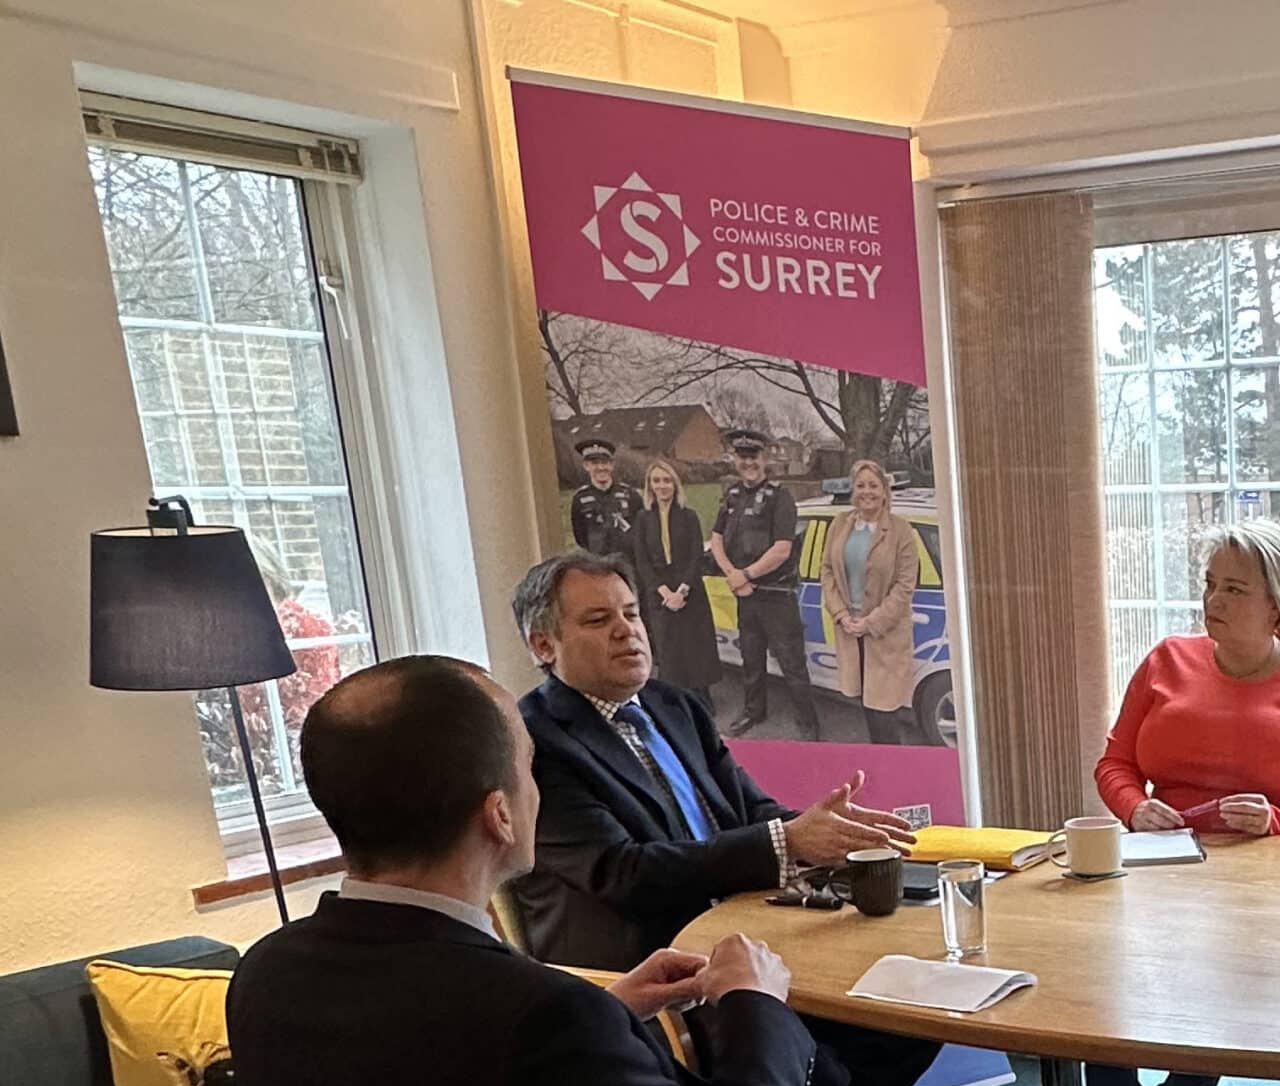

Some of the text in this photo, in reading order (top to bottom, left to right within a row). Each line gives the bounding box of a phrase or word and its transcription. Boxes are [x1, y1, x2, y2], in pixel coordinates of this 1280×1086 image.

[709, 198, 880, 234] POLICE & CRIME
[712, 226, 882, 256] COMMISSIONER FOR
[716, 251, 882, 299] SURREY
